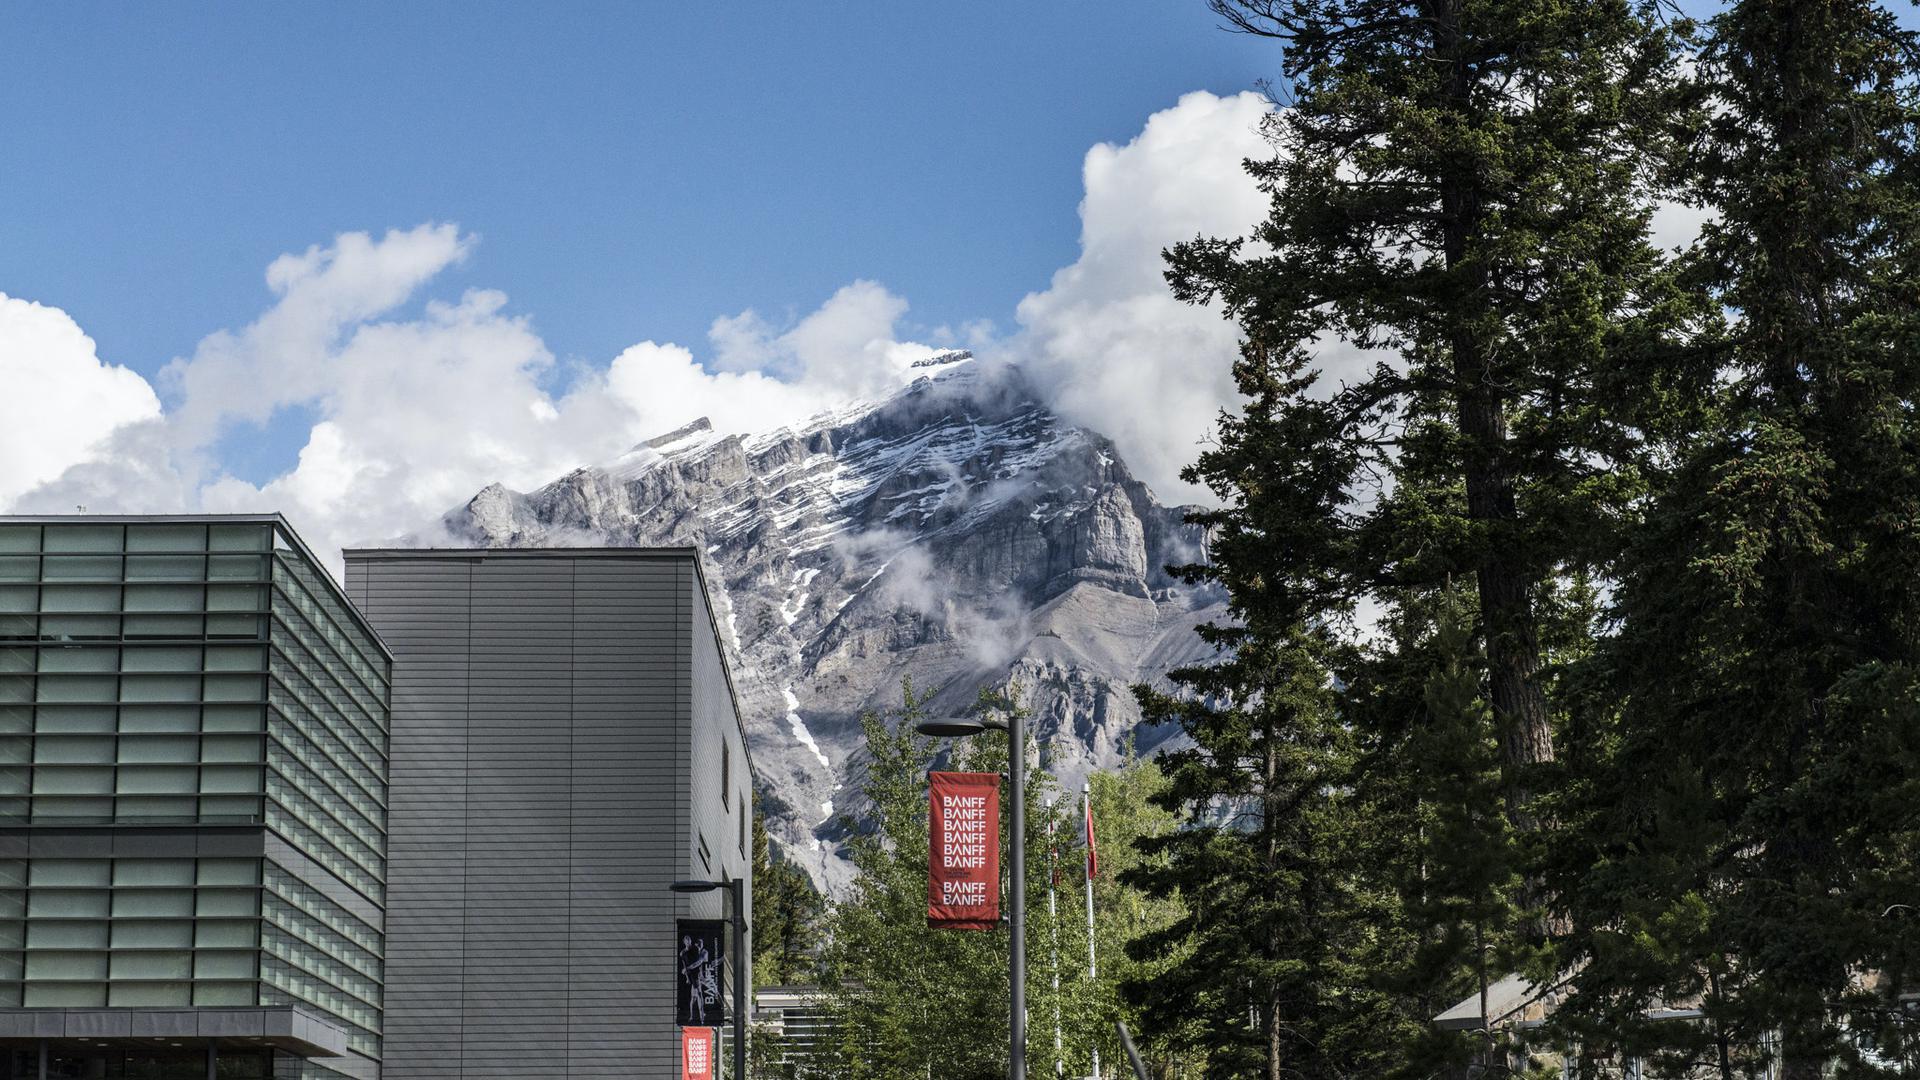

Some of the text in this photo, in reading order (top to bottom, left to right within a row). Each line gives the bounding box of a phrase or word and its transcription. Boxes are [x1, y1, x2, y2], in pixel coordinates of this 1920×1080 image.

[943, 796, 986, 808] BANFF
[943, 808, 986, 819] BANFF
[943, 820, 986, 832] BANFF
[943, 832, 986, 844] BANFF
[943, 844, 986, 856] BANFF
[943, 856, 986, 868] BANFF
[943, 880, 986, 893] BANFF
[943, 893, 986, 905] BANFF
[705, 963, 714, 1005] BANFF
